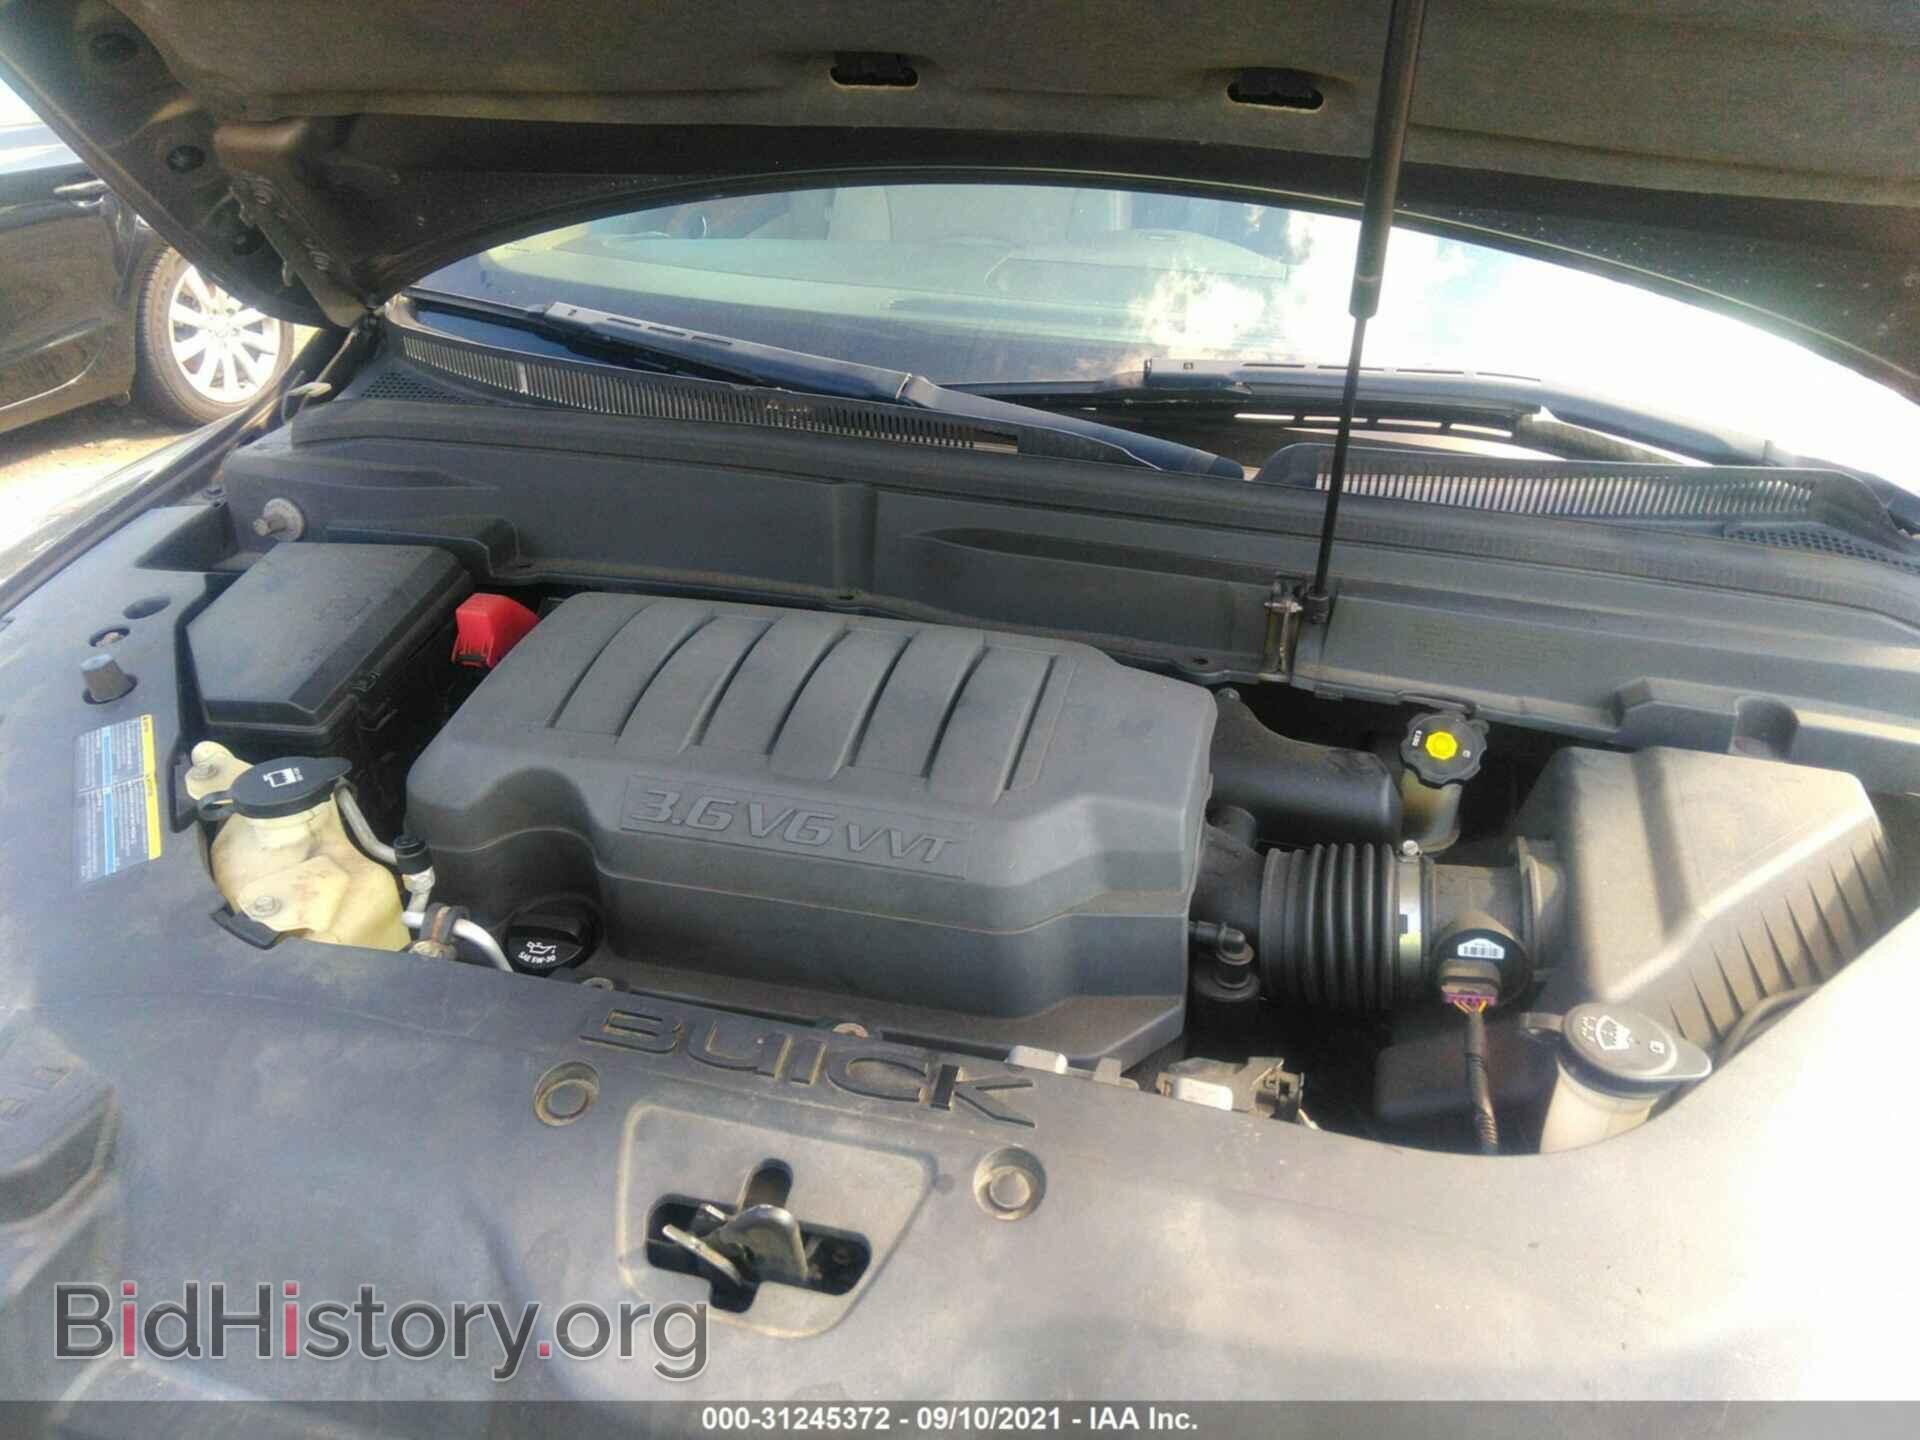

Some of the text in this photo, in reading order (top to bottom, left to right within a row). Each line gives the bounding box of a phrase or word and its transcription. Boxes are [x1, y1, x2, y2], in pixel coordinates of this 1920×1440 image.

[631, 788, 960, 865] 3.6 V6 VVT
[579, 1007, 1036, 1129] BUICK
